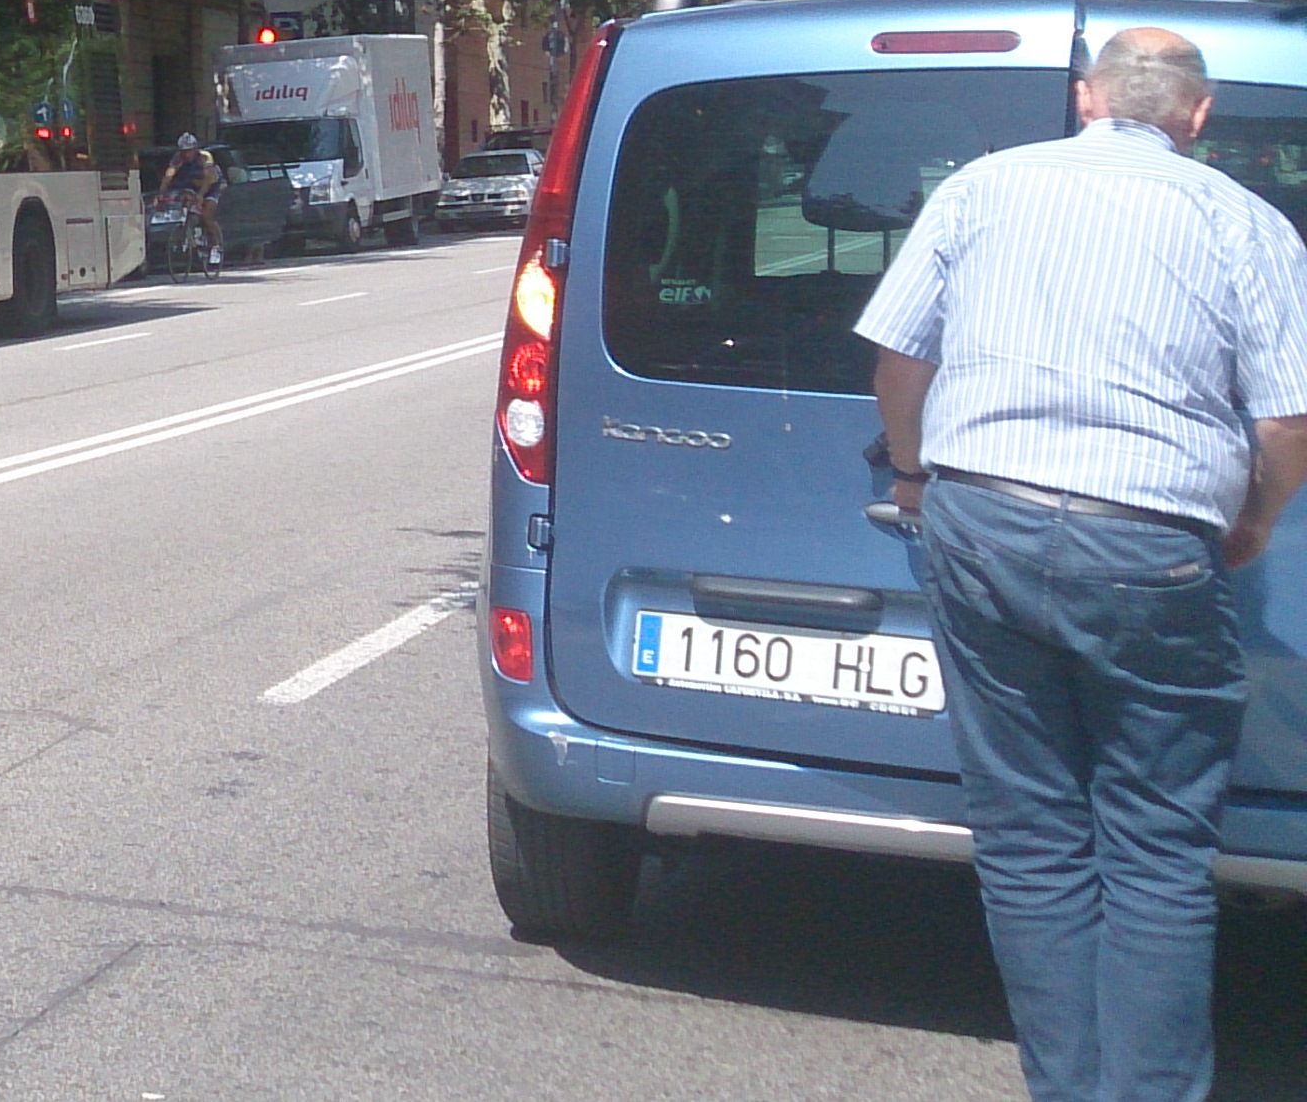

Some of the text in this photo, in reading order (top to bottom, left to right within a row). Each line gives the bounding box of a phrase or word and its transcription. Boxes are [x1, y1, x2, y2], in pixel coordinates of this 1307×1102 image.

[602, 415, 732, 449] kangoo
[642, 650, 654, 665] E
[681, 627, 930, 699] 1160 HLG
